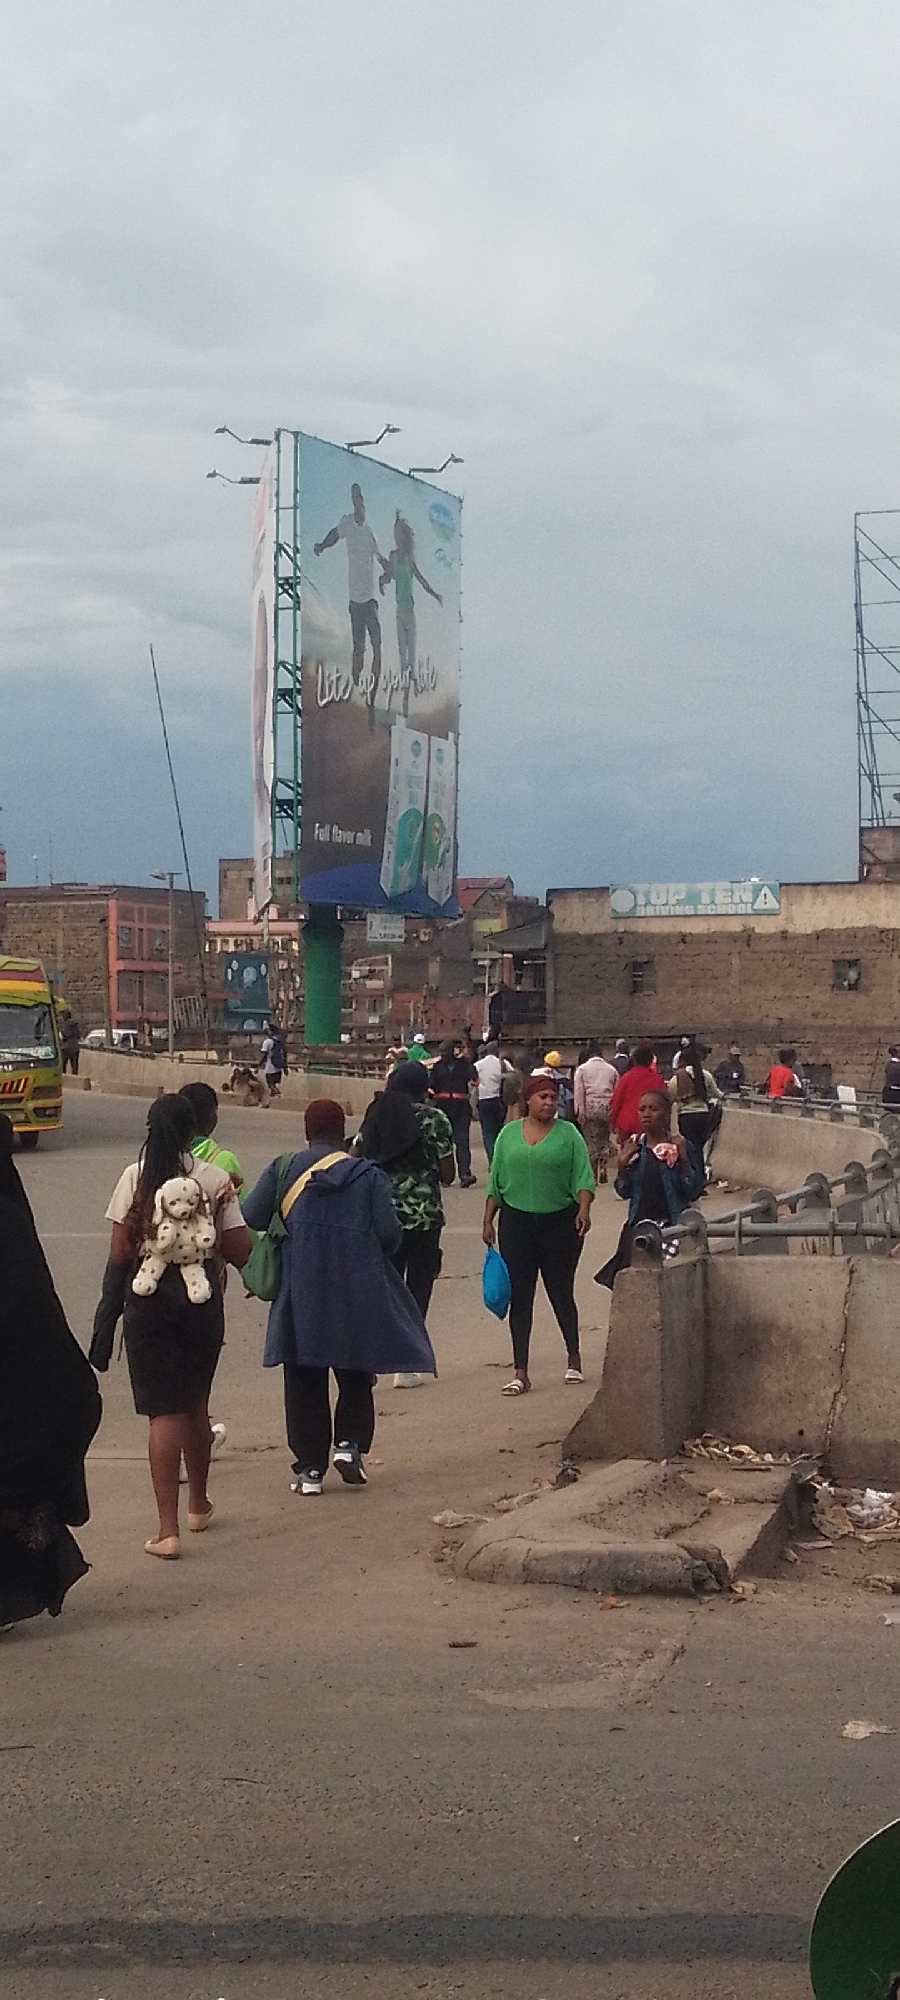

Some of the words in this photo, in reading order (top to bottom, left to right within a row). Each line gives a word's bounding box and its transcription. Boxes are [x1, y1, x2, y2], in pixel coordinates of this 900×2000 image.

[313, 822, 331, 842] Full
[632, 884, 687, 906] TOP
[697, 882, 752, 906] TEN
[635, 905, 695, 916] DRIVING
[697, 903, 752, 915] SCHOOL
